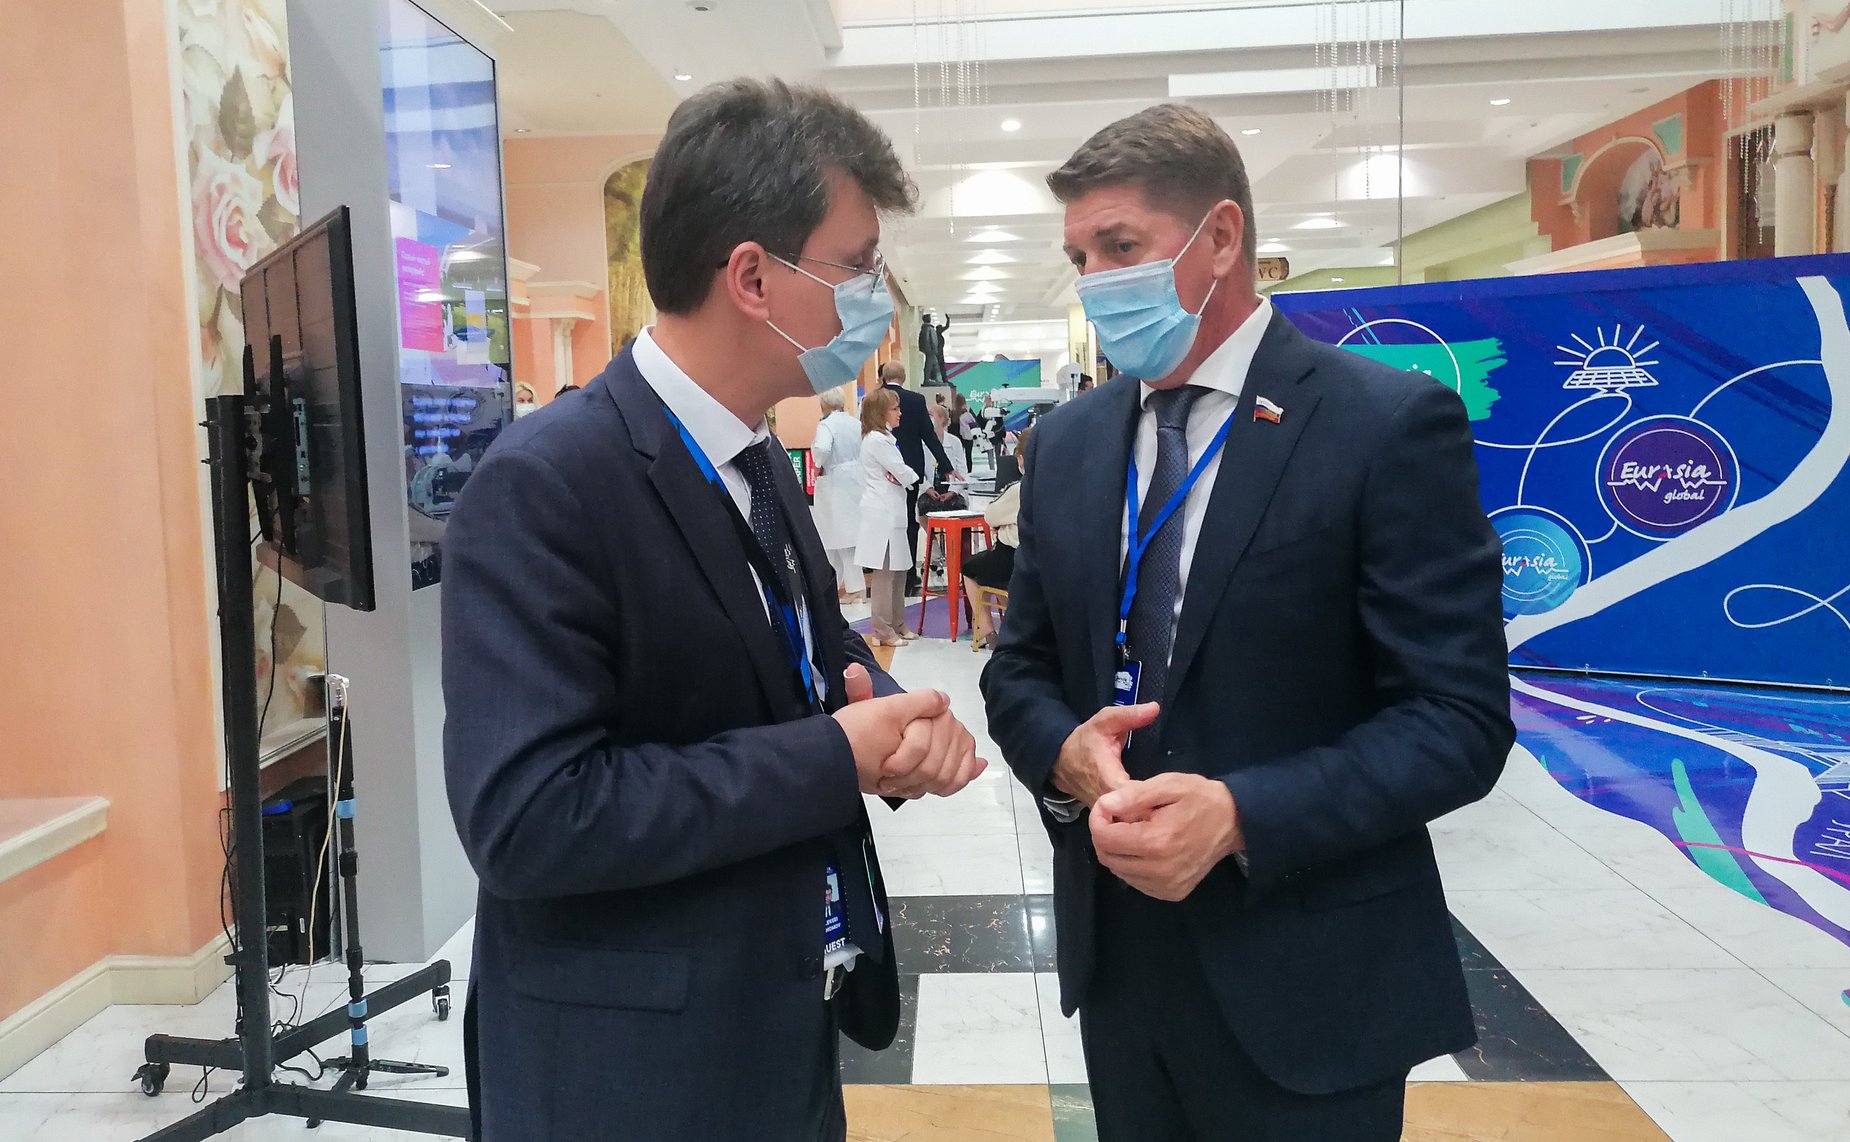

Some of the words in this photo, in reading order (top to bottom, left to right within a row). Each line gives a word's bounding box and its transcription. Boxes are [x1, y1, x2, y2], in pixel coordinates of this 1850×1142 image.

[1663, 489, 1705, 504] global
[1501, 552, 1558, 568] urasia
[824, 937, 846, 954] UEST
